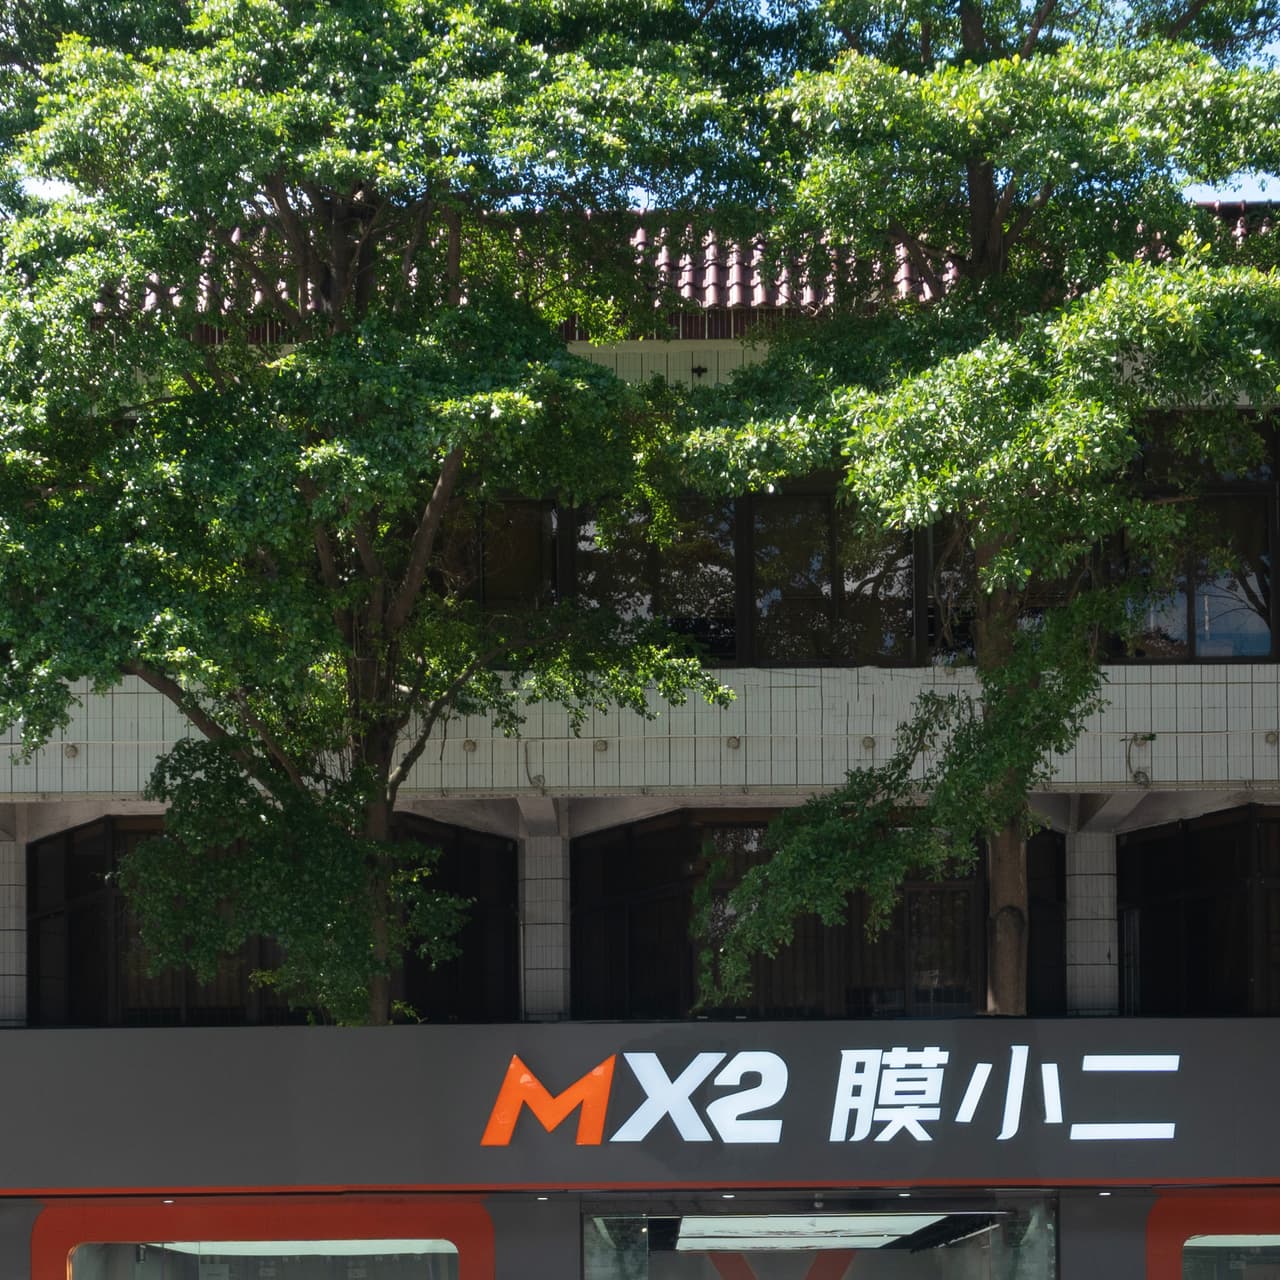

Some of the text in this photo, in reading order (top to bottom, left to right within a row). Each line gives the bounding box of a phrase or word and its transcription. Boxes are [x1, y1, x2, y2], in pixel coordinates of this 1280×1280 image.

[481, 1051, 789, 1146] MX2
[829, 1045, 1180, 1142] 膜小二
